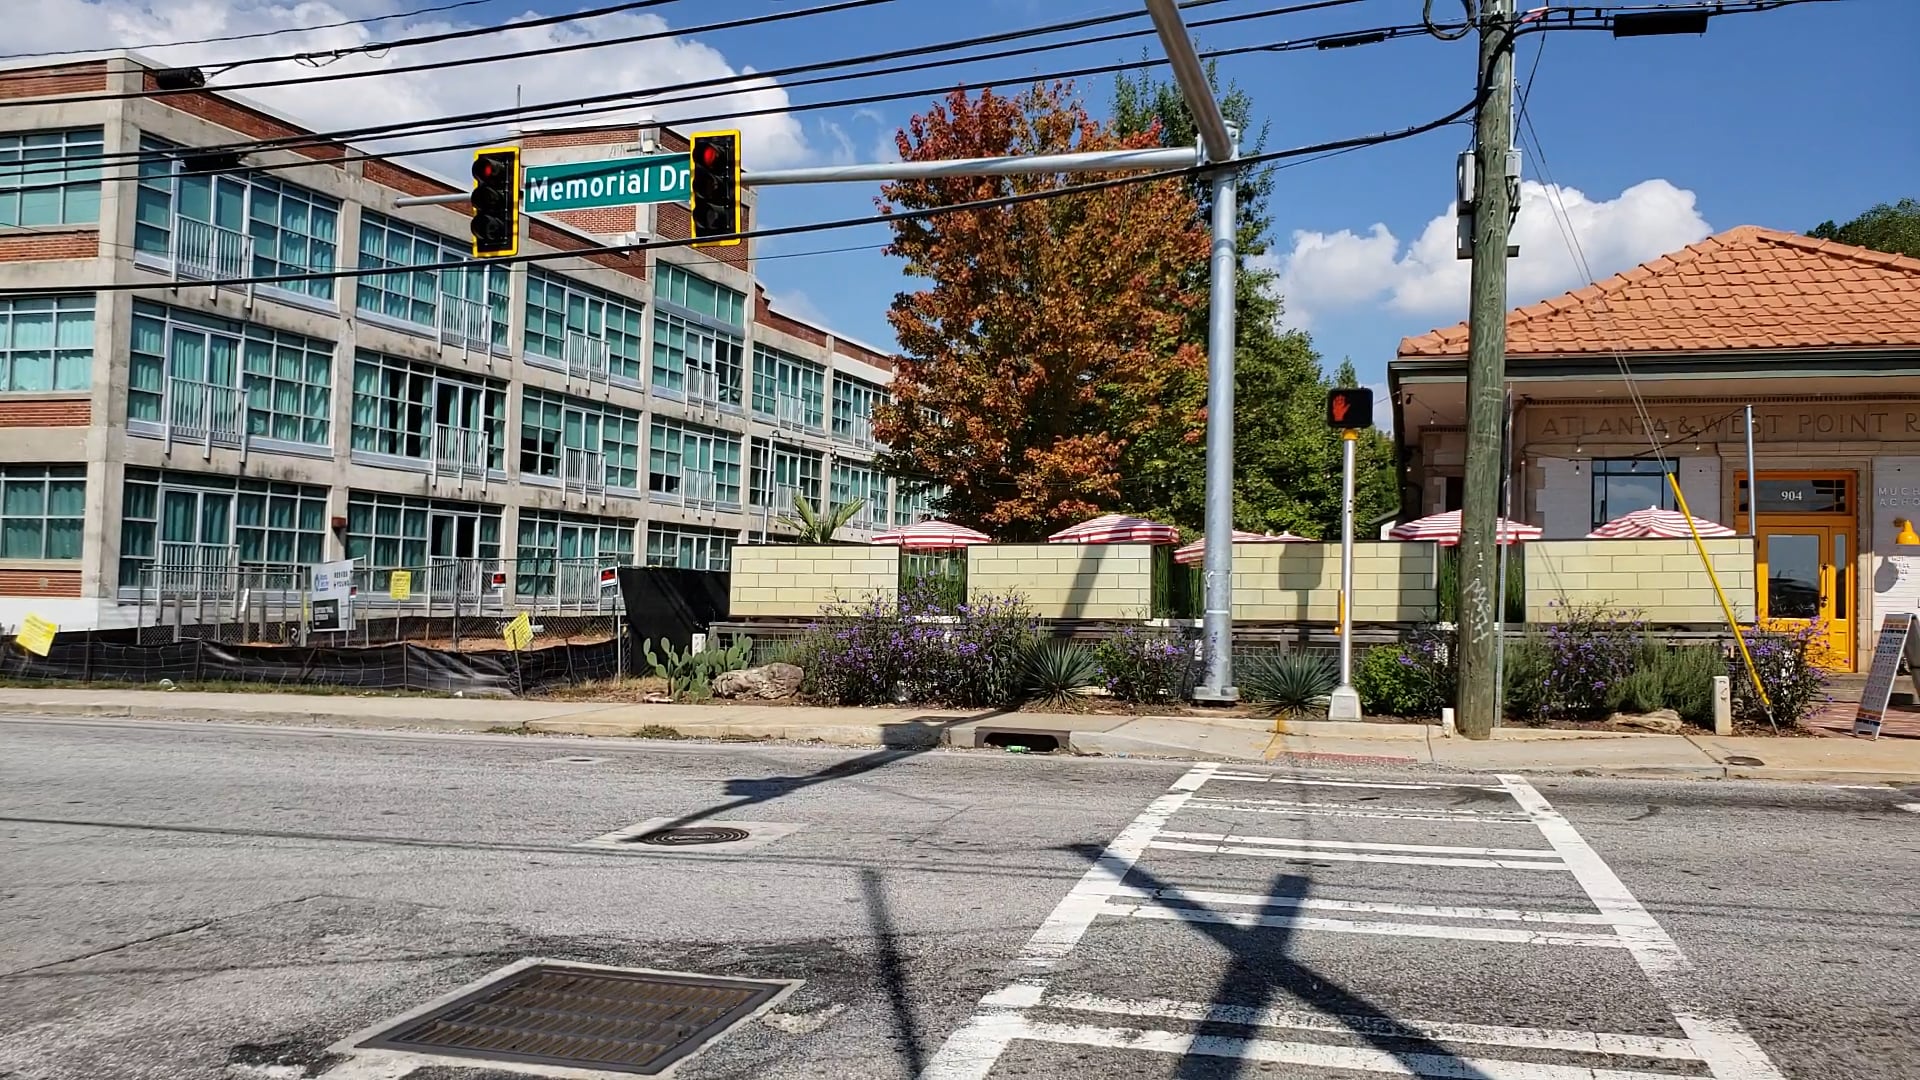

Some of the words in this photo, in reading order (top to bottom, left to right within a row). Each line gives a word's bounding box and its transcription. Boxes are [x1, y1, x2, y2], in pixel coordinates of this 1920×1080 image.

[530, 167, 649, 203] Memorial
[659, 165, 690, 192] Dr
[1542, 415, 1667, 436] ATLANTA
[1678, 415, 1695, 434] &
[1700, 414, 1783, 435] WEST
[1799, 413, 1888, 433] POINT
[1781, 490, 1802, 501] 904
